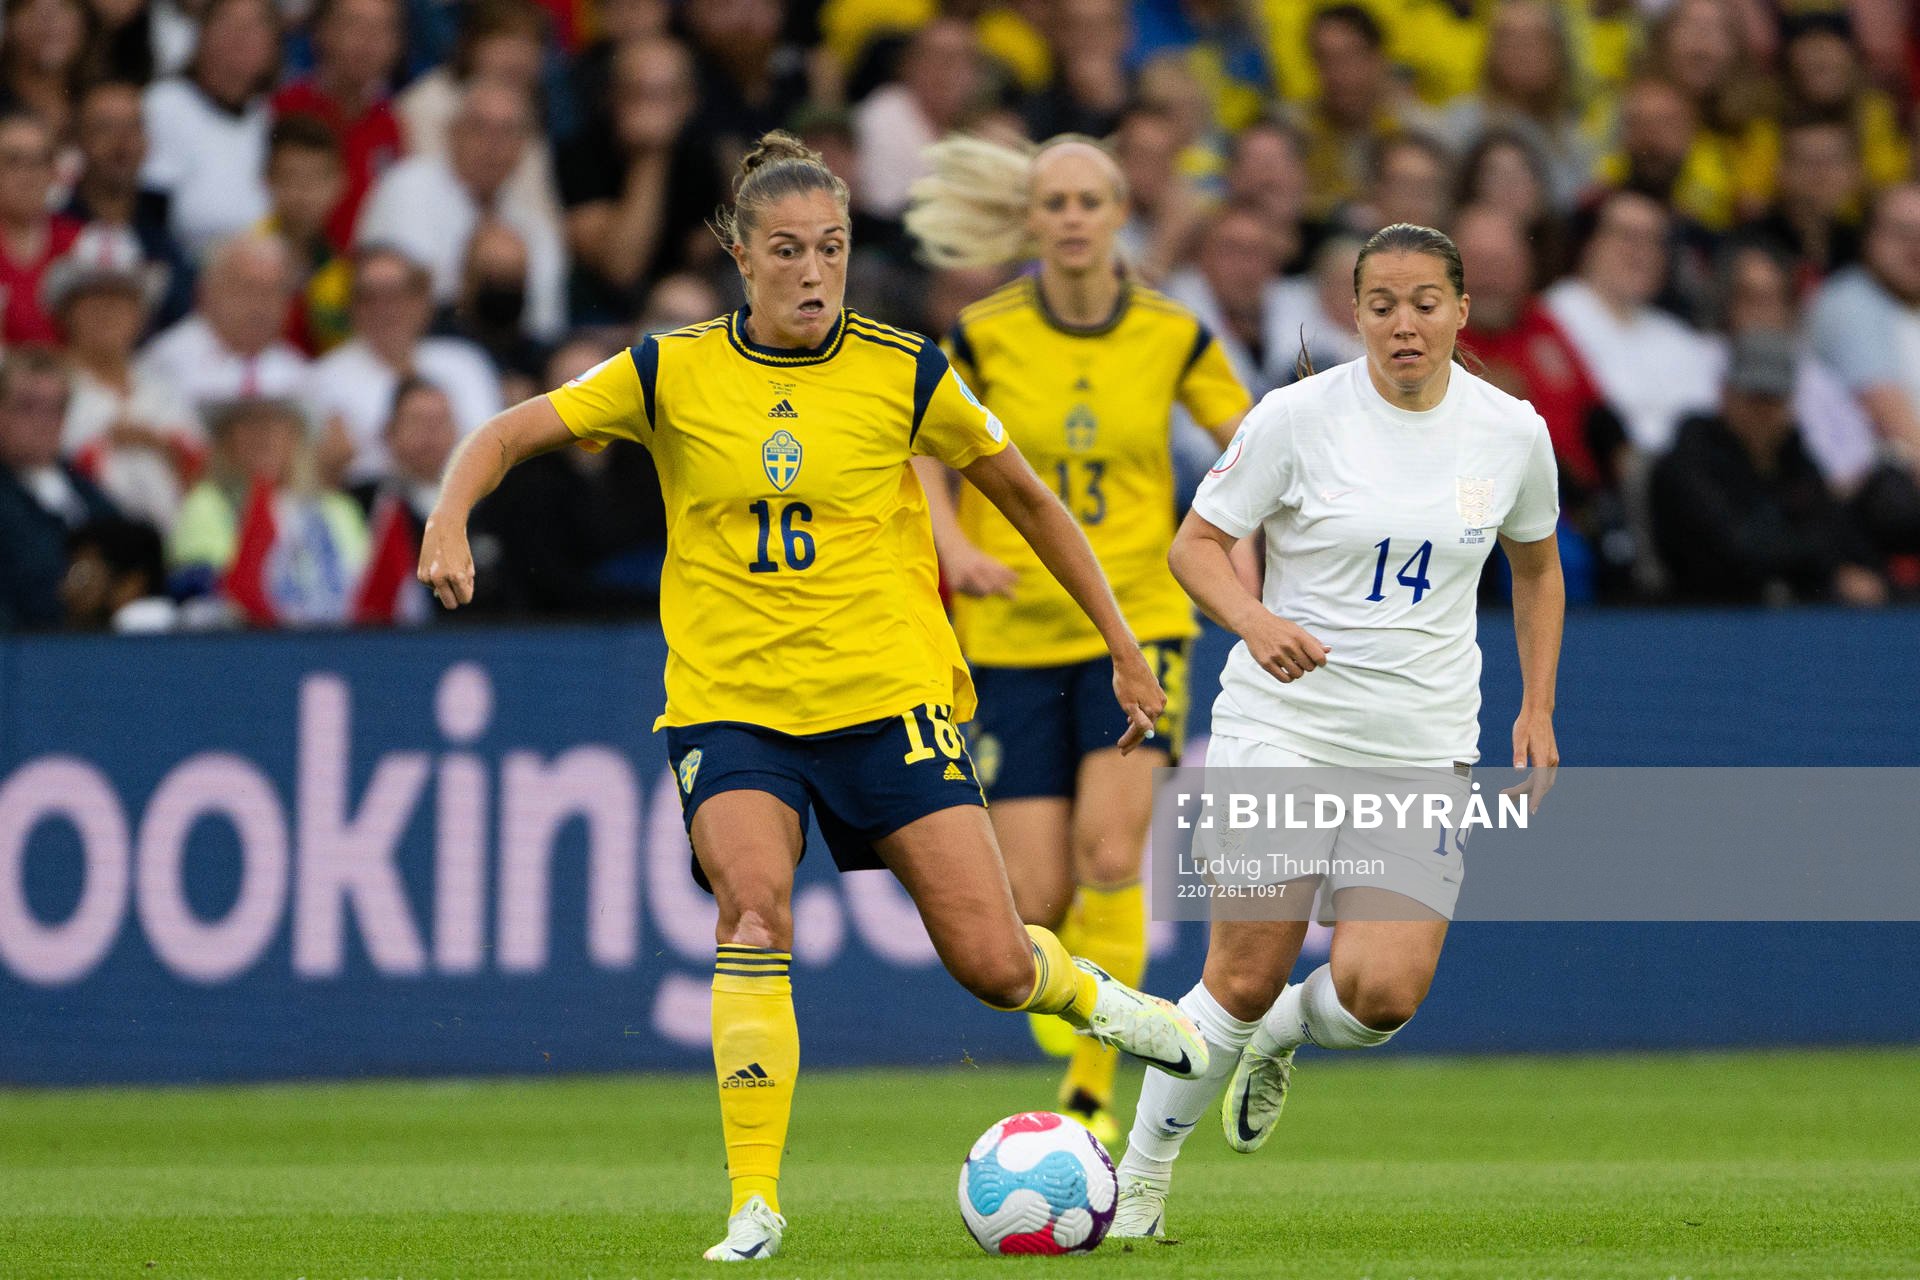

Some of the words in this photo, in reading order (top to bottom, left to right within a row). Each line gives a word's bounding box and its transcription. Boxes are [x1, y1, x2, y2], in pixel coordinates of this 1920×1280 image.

[1056, 460, 1107, 525] 13
[749, 499, 816, 573] 16
[1365, 536, 1433, 605] 14
[902, 703, 962, 765] 16
[721, 1077, 776, 1089] adidas
